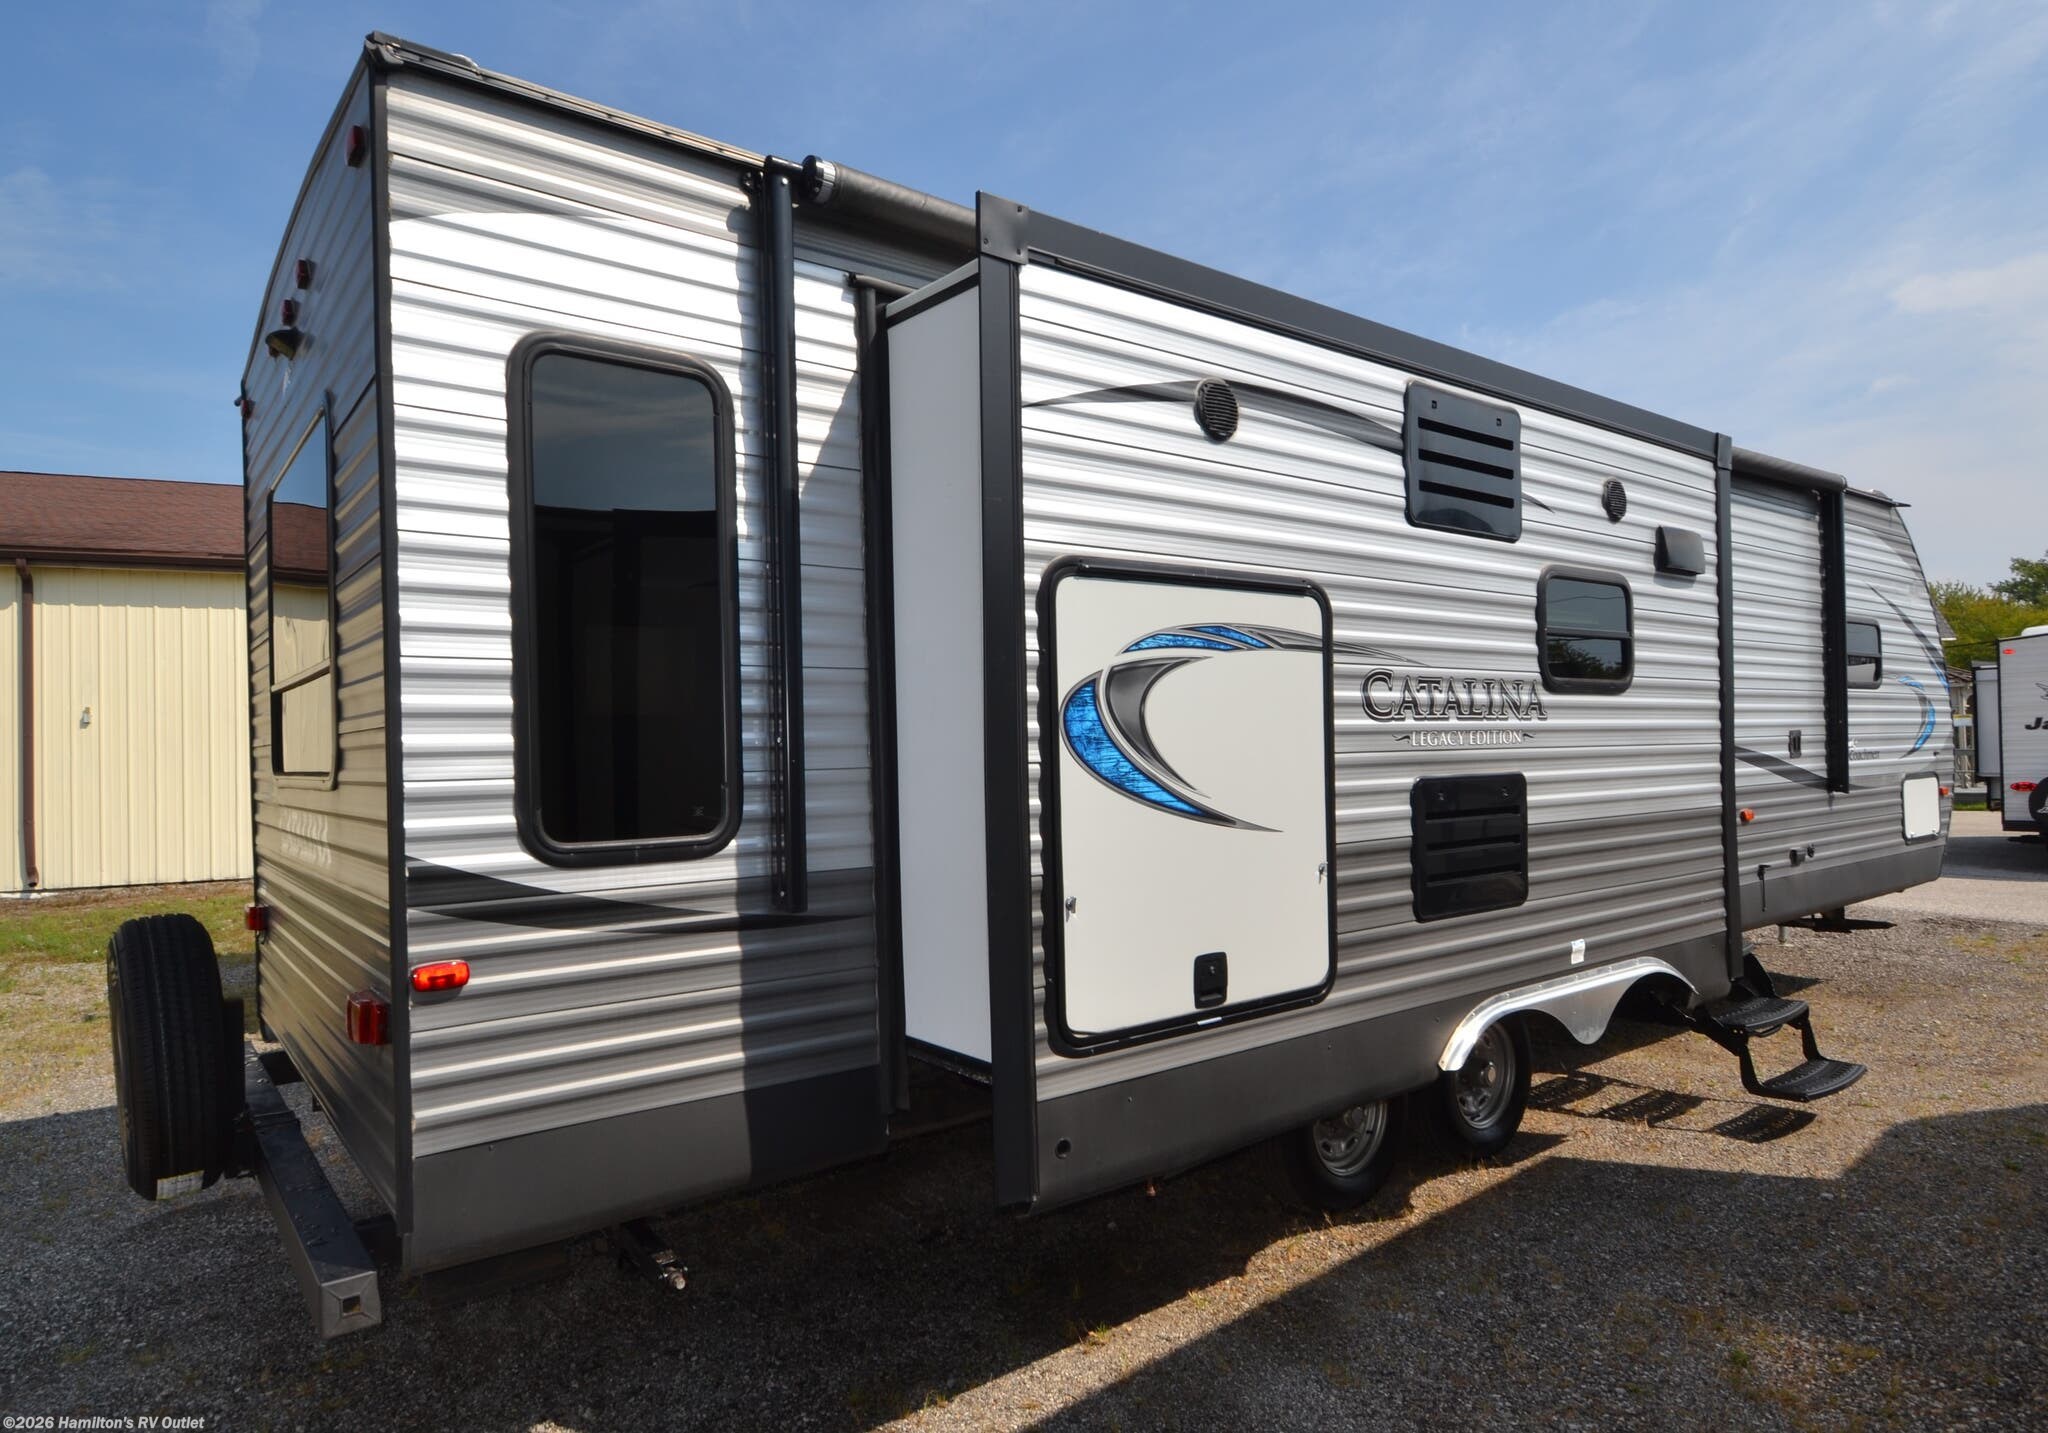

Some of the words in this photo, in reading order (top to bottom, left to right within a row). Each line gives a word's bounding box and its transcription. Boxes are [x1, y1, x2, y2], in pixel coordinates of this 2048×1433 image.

[1361, 668, 1547, 722] CATALINA
[1411, 730, 1465, 746] LEGACY
[1469, 729, 1522, 745] EDITION
